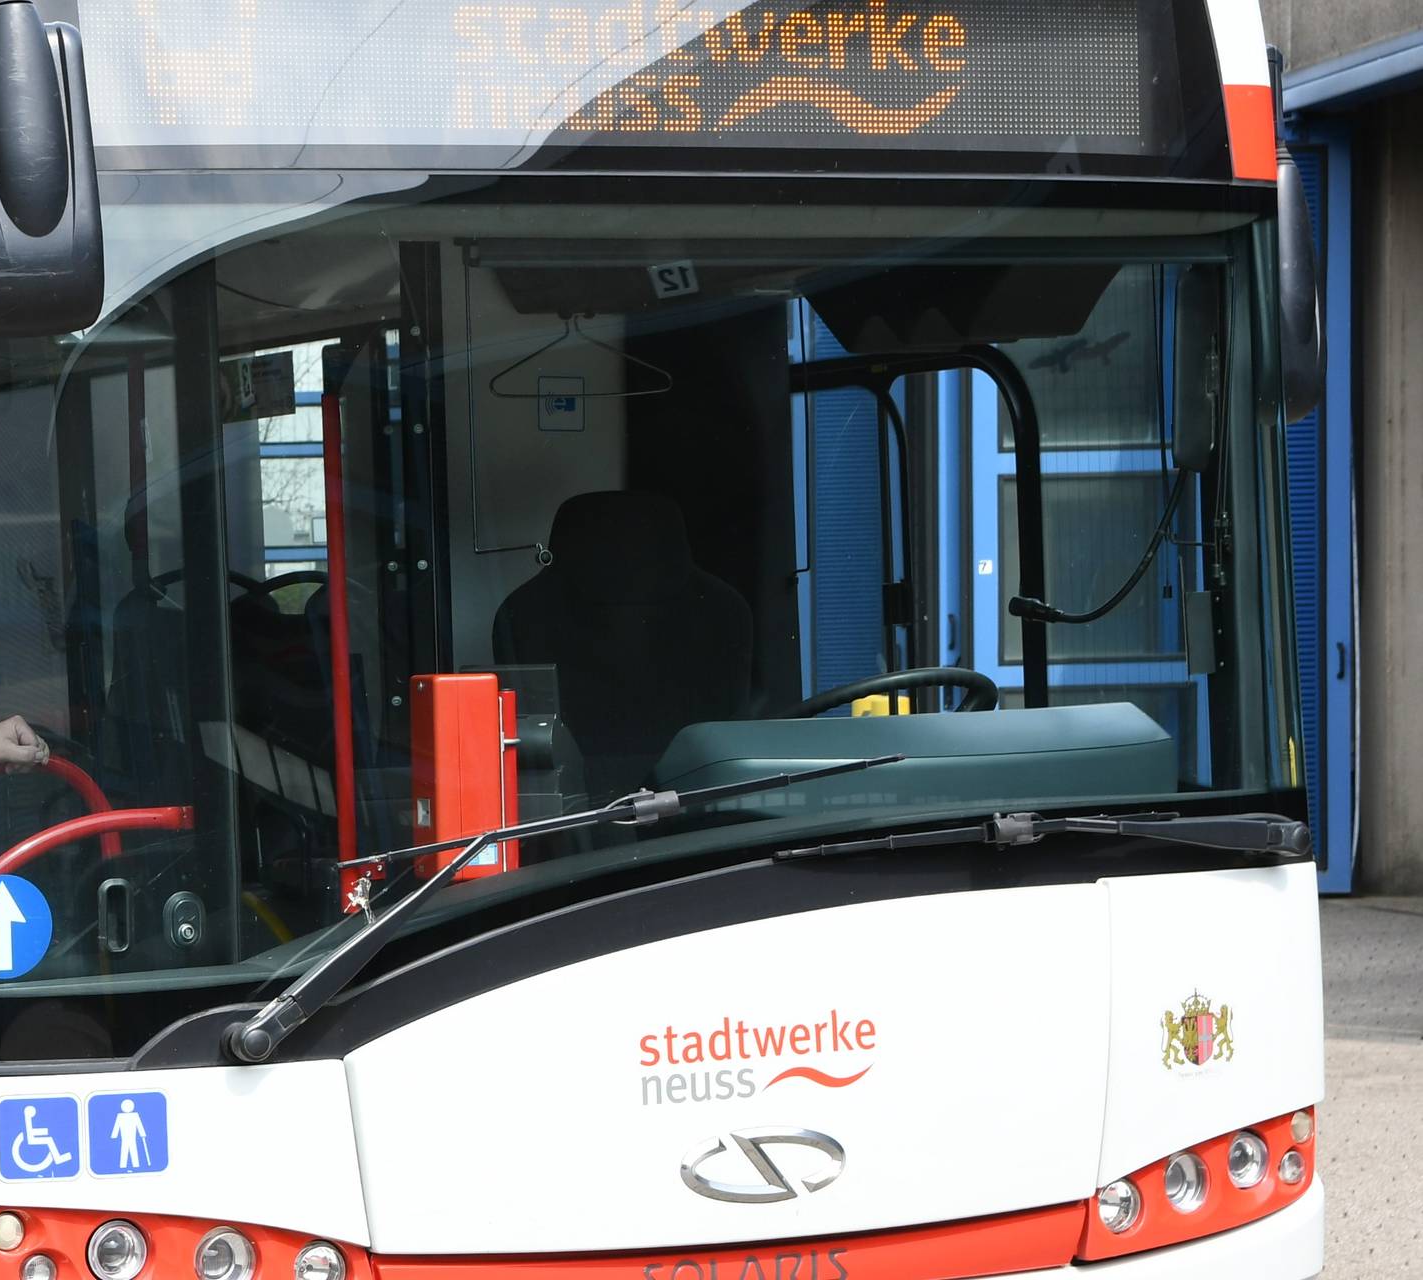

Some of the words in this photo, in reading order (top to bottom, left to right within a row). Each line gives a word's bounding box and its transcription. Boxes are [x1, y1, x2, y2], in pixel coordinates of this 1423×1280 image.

[453, 0, 968, 71] stadtwerke
[640, 1009, 876, 1067] stadtwerke
[641, 1068, 756, 1106] neuss
